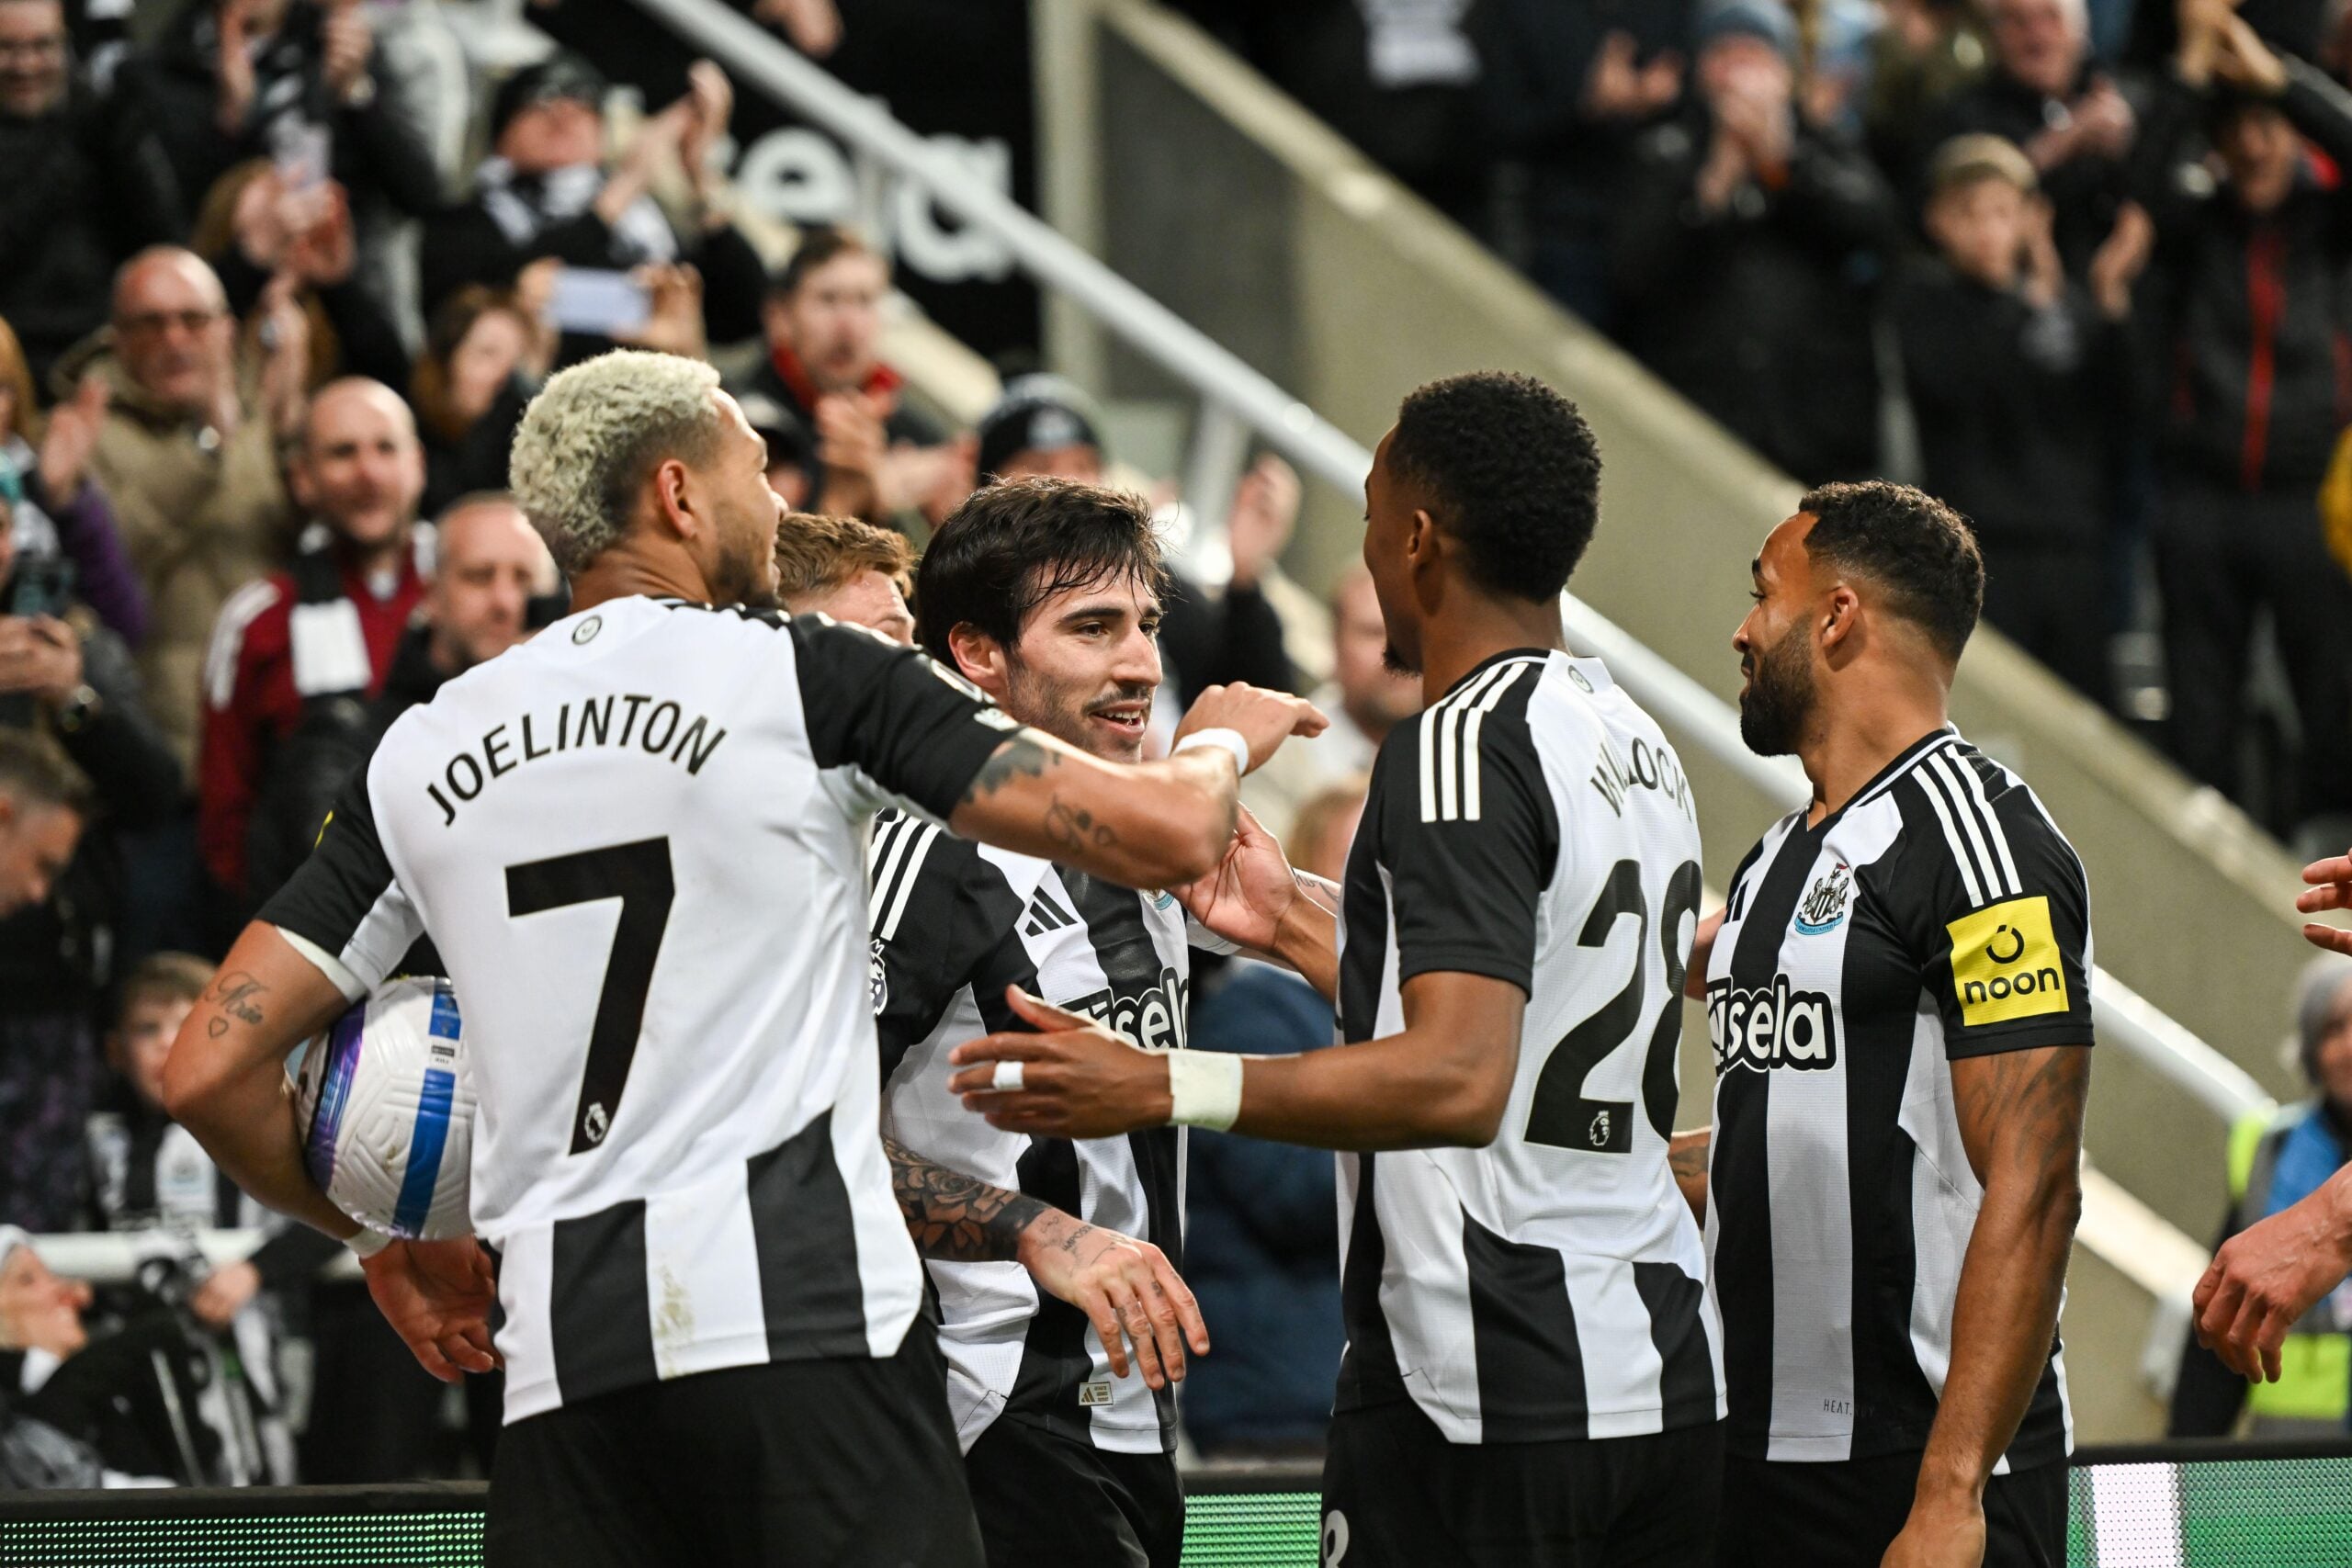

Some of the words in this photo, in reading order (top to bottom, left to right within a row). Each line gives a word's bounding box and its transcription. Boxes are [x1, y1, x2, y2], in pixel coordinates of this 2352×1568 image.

[426, 694, 727, 828] JOELINTON
[504, 835, 675, 1157] 7
[1523, 858, 1702, 1154] 28
[1963, 967, 2060, 1004] noon
